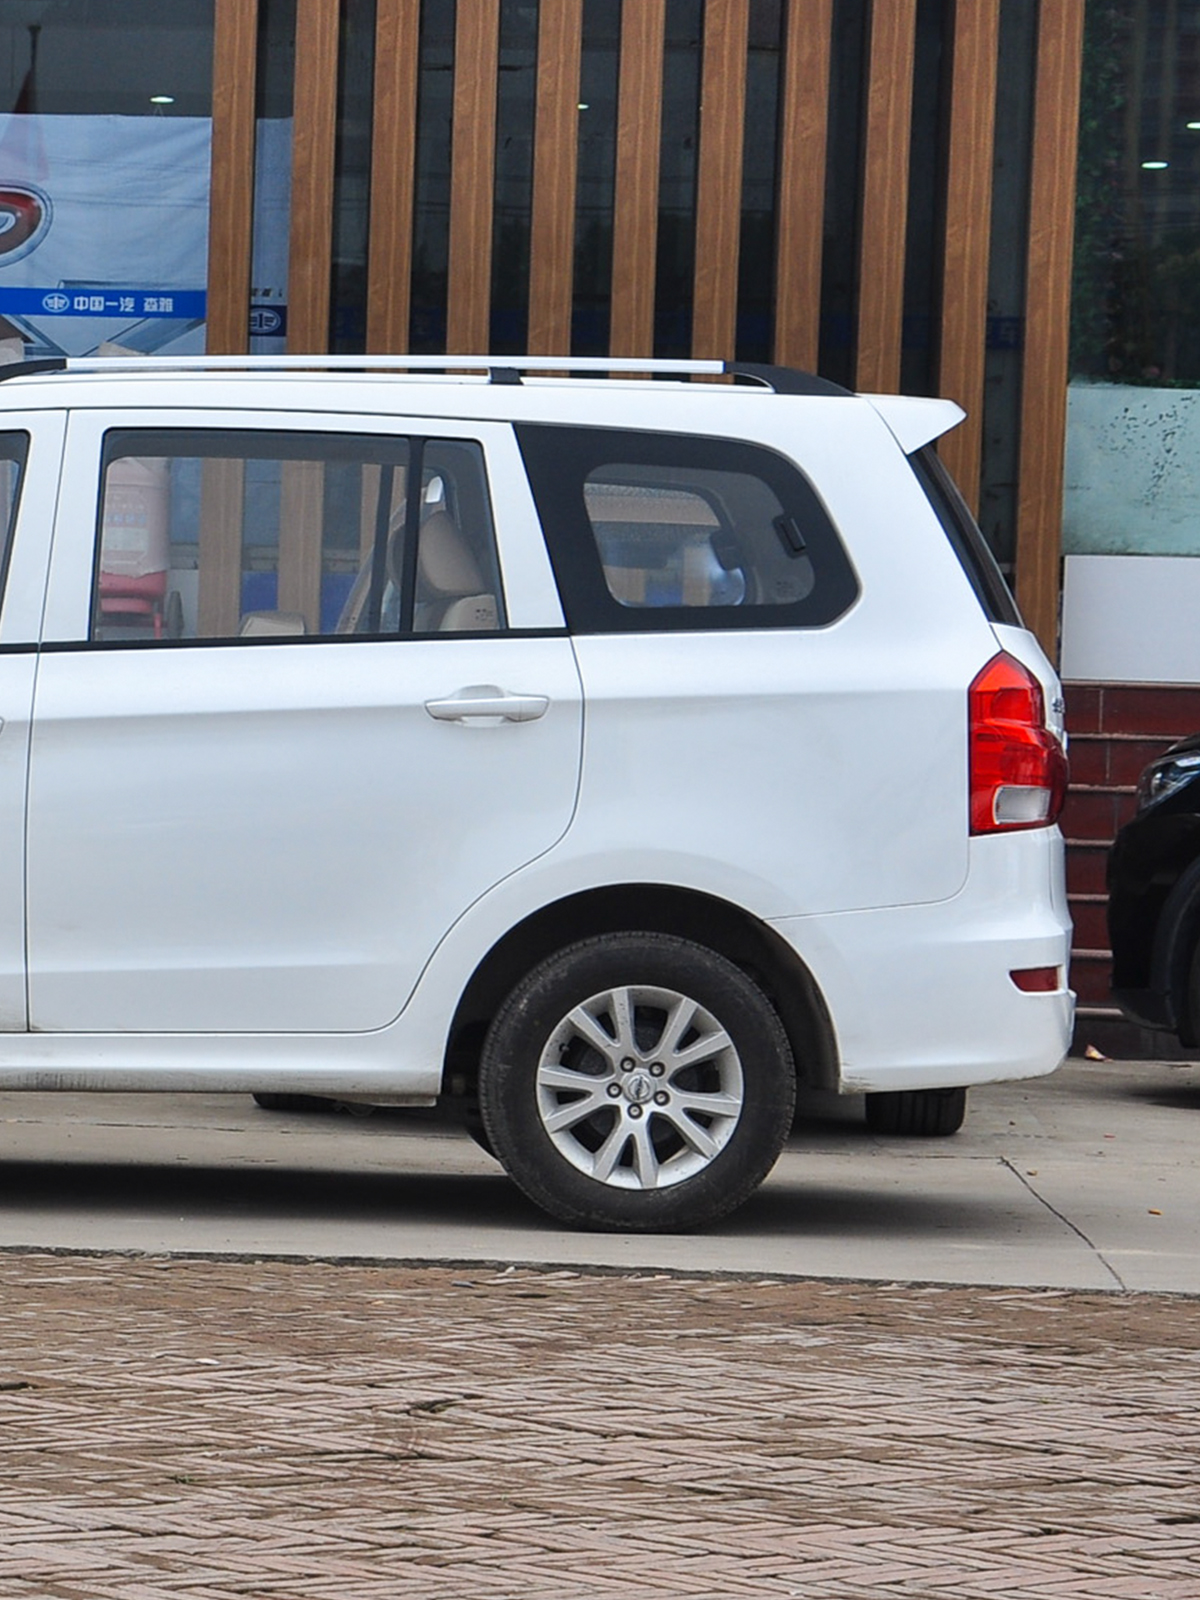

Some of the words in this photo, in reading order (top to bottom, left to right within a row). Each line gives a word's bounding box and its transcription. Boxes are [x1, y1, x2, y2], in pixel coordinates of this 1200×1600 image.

[73, 295, 135, 313] 中国一汽
[143, 297, 174, 313] 森雅
